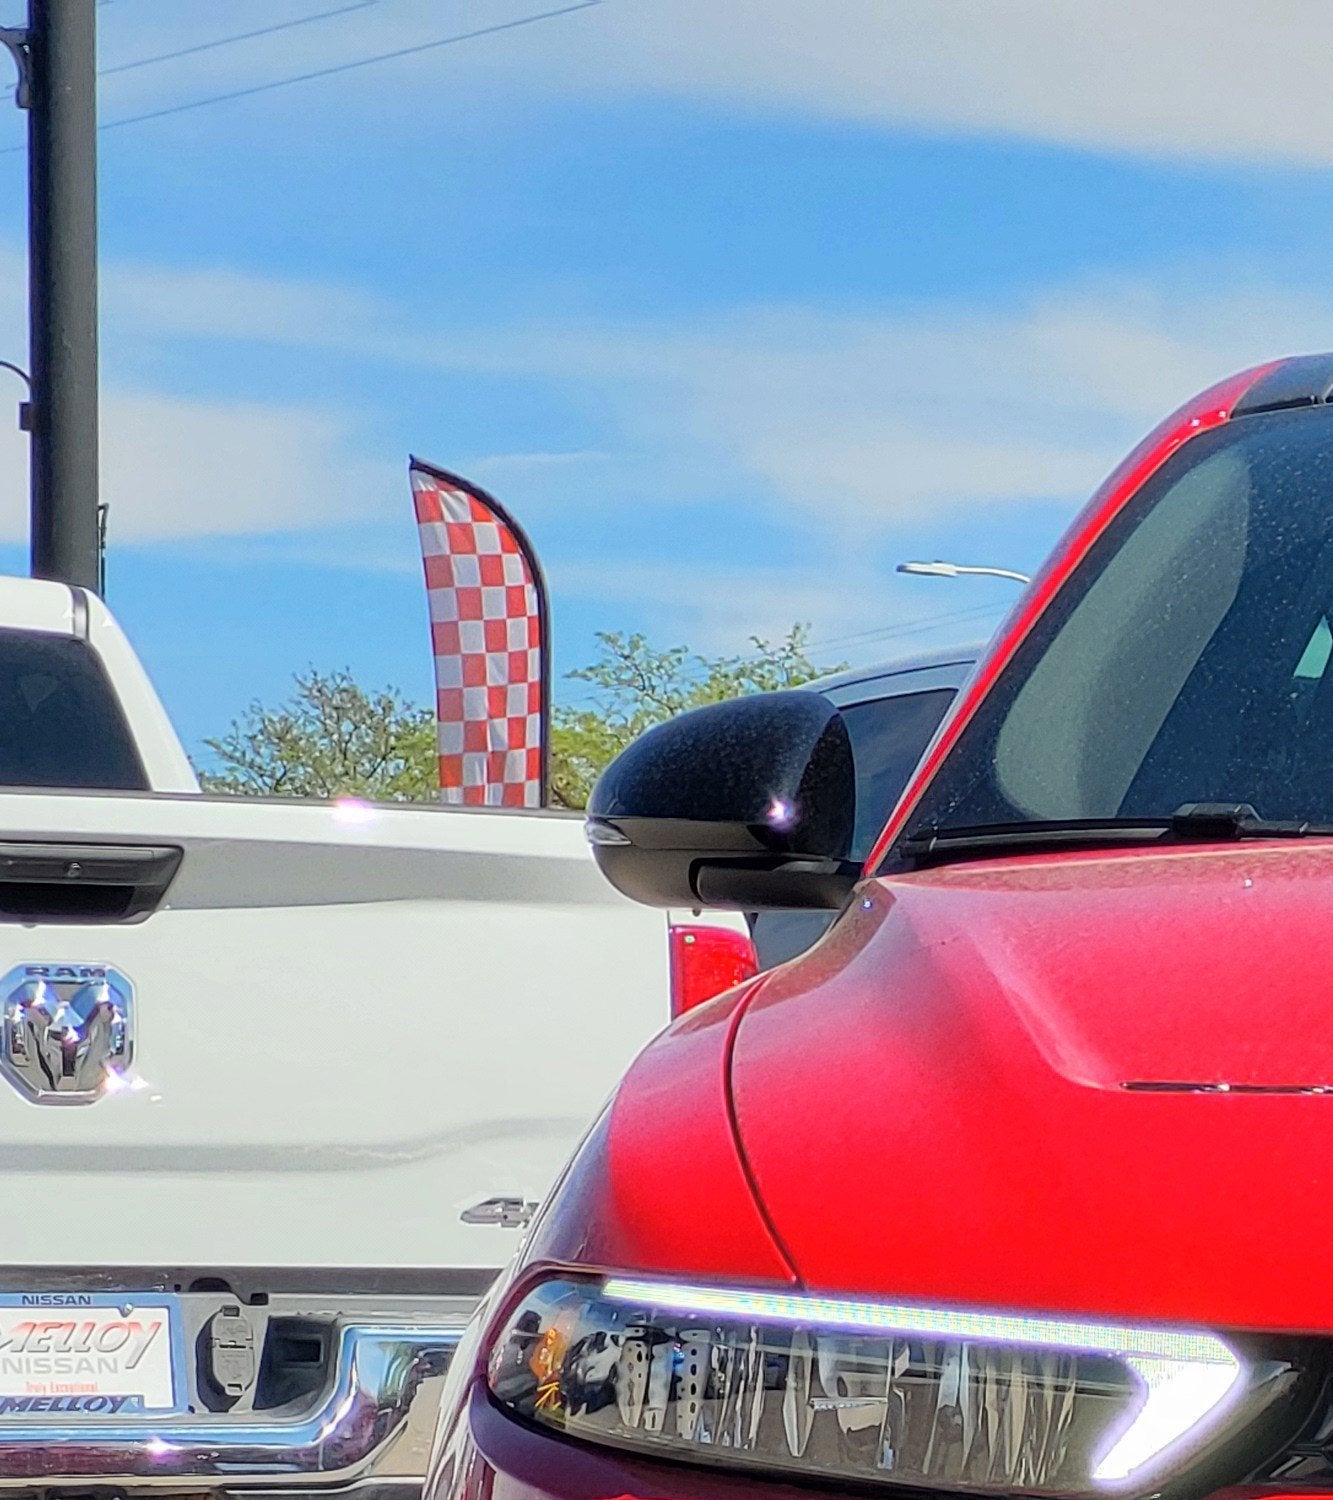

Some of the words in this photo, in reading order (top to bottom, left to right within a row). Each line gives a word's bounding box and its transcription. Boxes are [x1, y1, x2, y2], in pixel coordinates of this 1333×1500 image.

[24, 966, 106, 978] RAM
[21, 1295, 92, 1305] NISSAN
[2, 1357, 119, 1375] NISSAN
[0, 1396, 126, 1414] MELLOY
